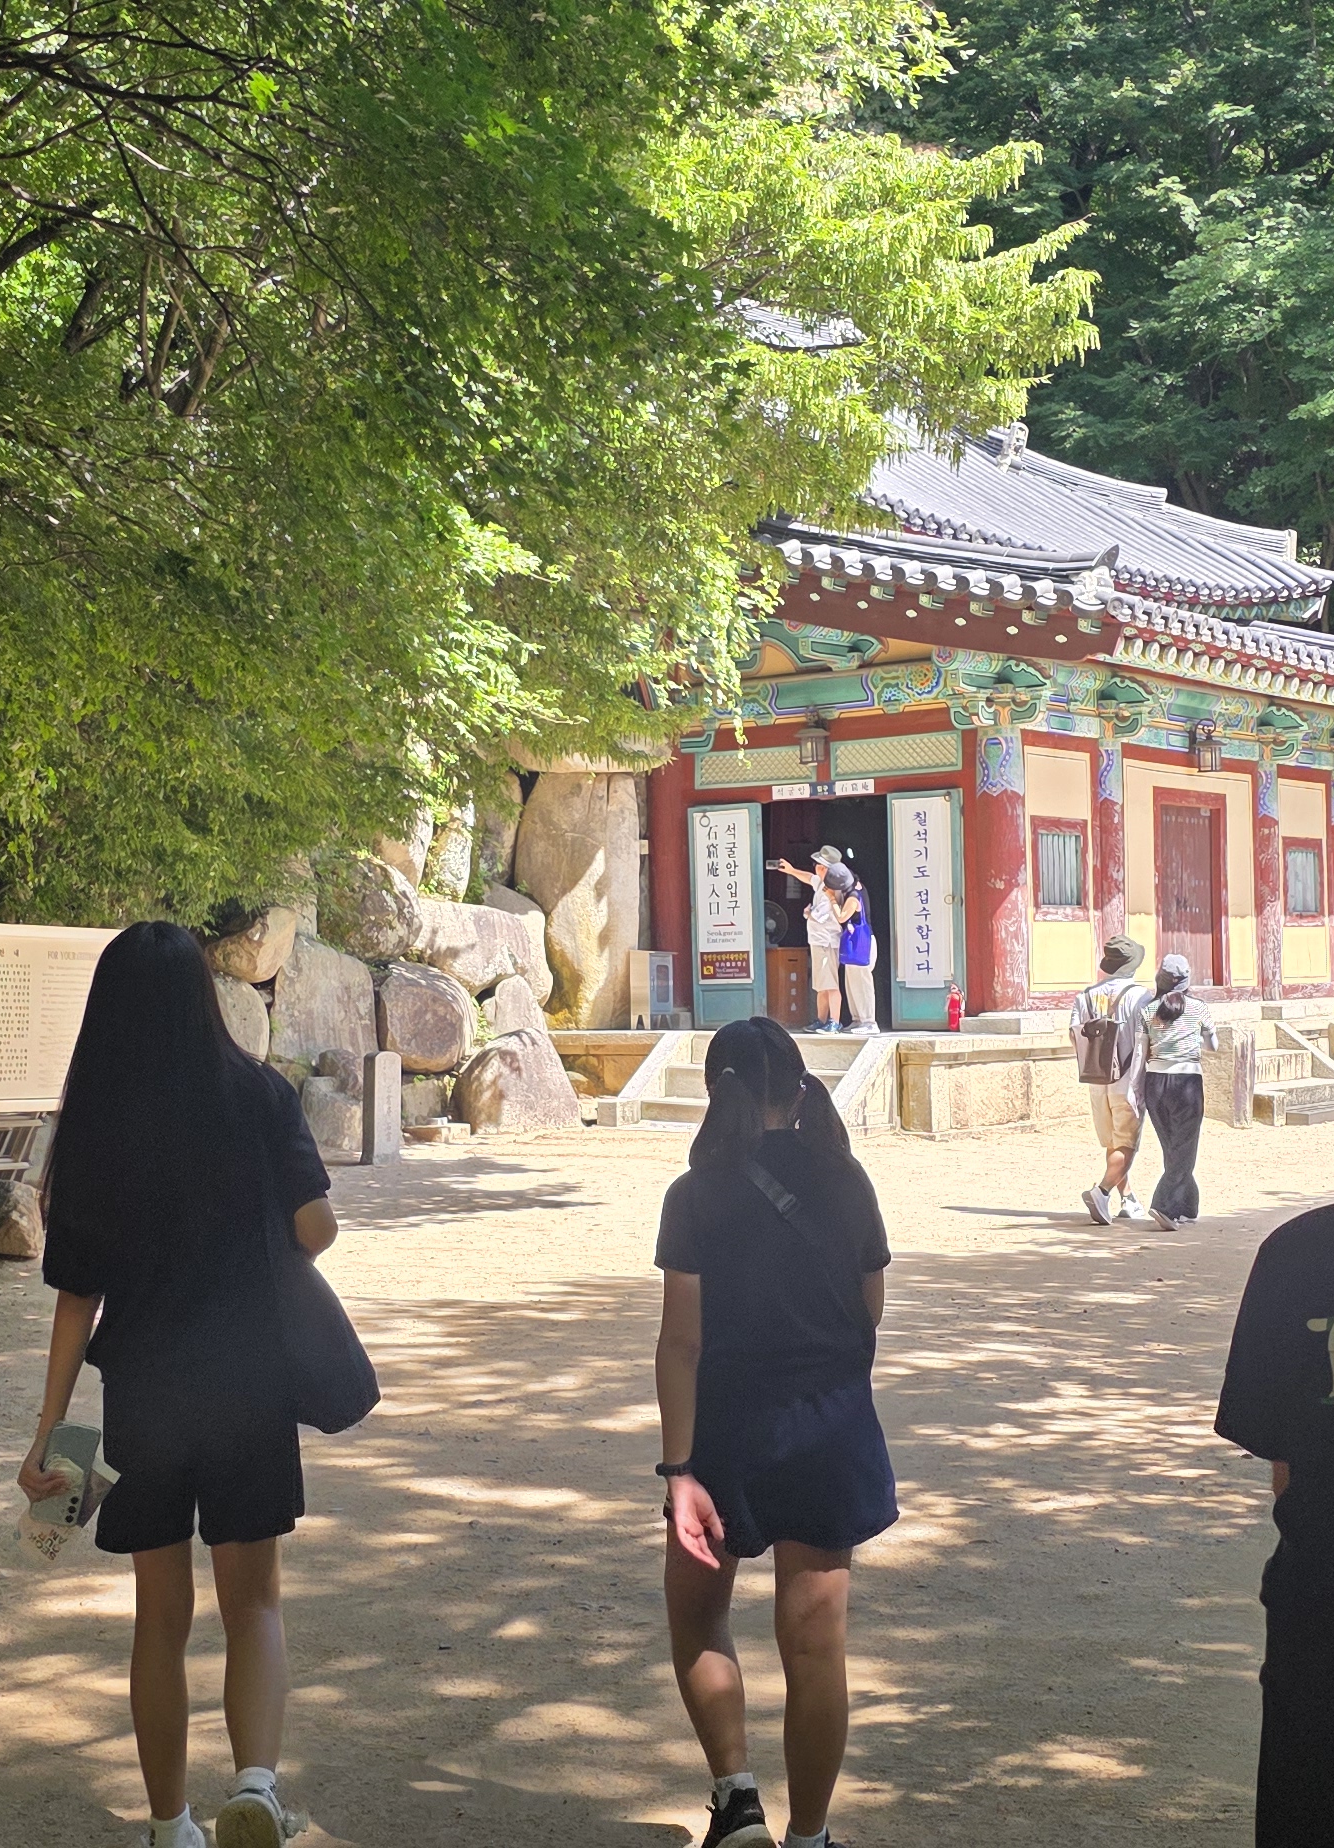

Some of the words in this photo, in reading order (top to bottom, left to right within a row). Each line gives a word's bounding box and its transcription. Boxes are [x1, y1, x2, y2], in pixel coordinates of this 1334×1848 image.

[725, 823, 739, 877] 석굴암
[912, 811, 931, 879] 칠석기도
[727, 881, 740, 917] 입구
[48, 951, 59, 960] FOR
[914, 889, 933, 975] 접수합니다
